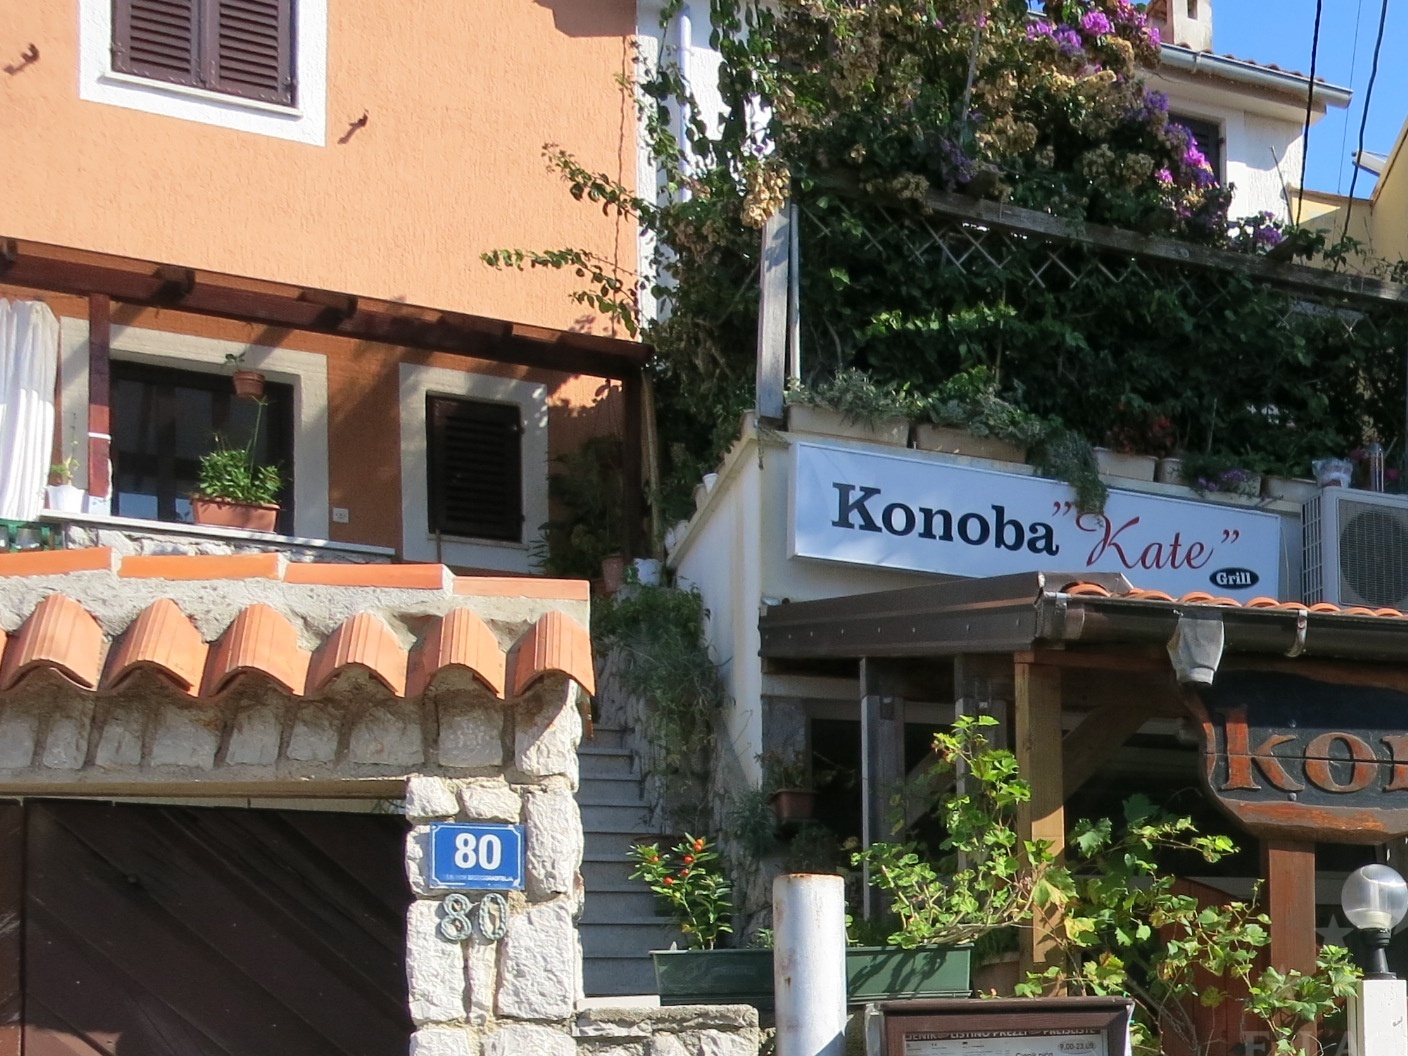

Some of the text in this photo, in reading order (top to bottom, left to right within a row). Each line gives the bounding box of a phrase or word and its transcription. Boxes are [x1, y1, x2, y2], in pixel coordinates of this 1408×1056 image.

[831, 481, 1060, 557] Konoba
[1215, 572, 1252, 586] Grill
[454, 832, 502, 871] 80
[440, 893, 508, 941] 80
